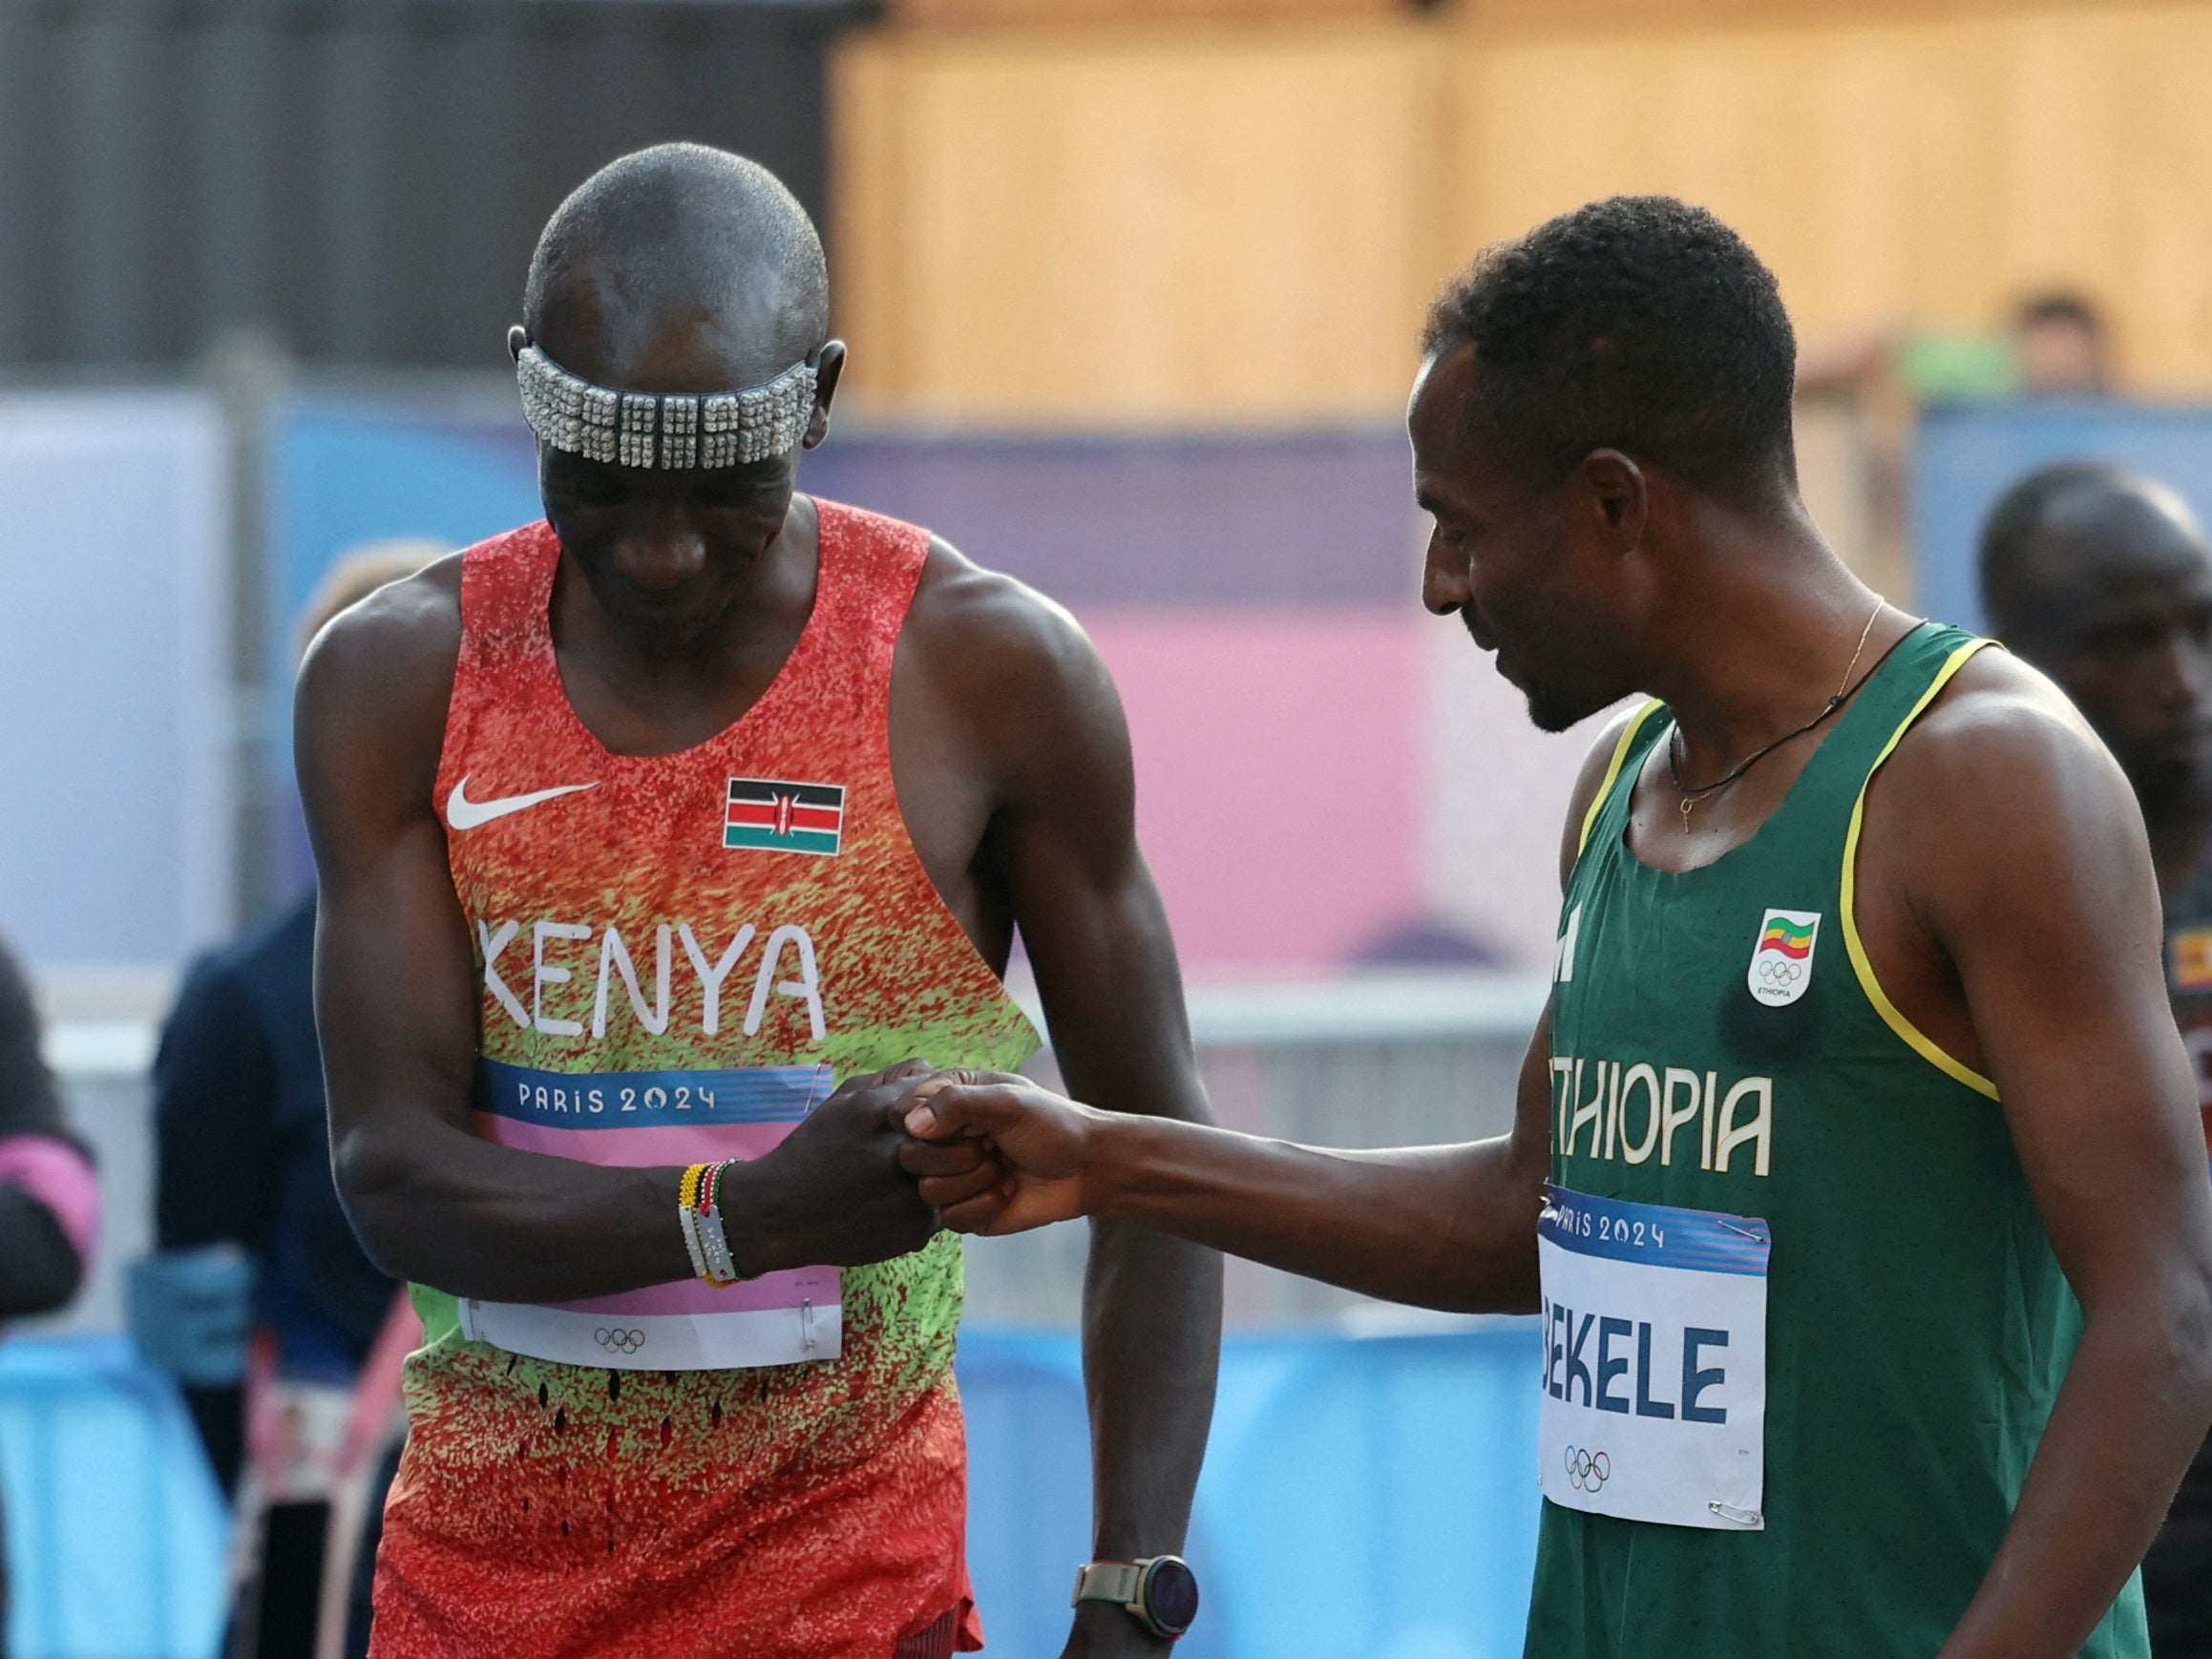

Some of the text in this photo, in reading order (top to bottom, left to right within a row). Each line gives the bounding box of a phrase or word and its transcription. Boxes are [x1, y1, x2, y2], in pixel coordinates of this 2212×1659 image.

[478, 919, 827, 1040] KENYA
[1758, 987, 1791, 998] ETHIOPIA
[621, 1086, 716, 1113] 2024
[1548, 1057, 1773, 1176] THIOPIA
[1599, 1215, 1664, 1249] 2024
